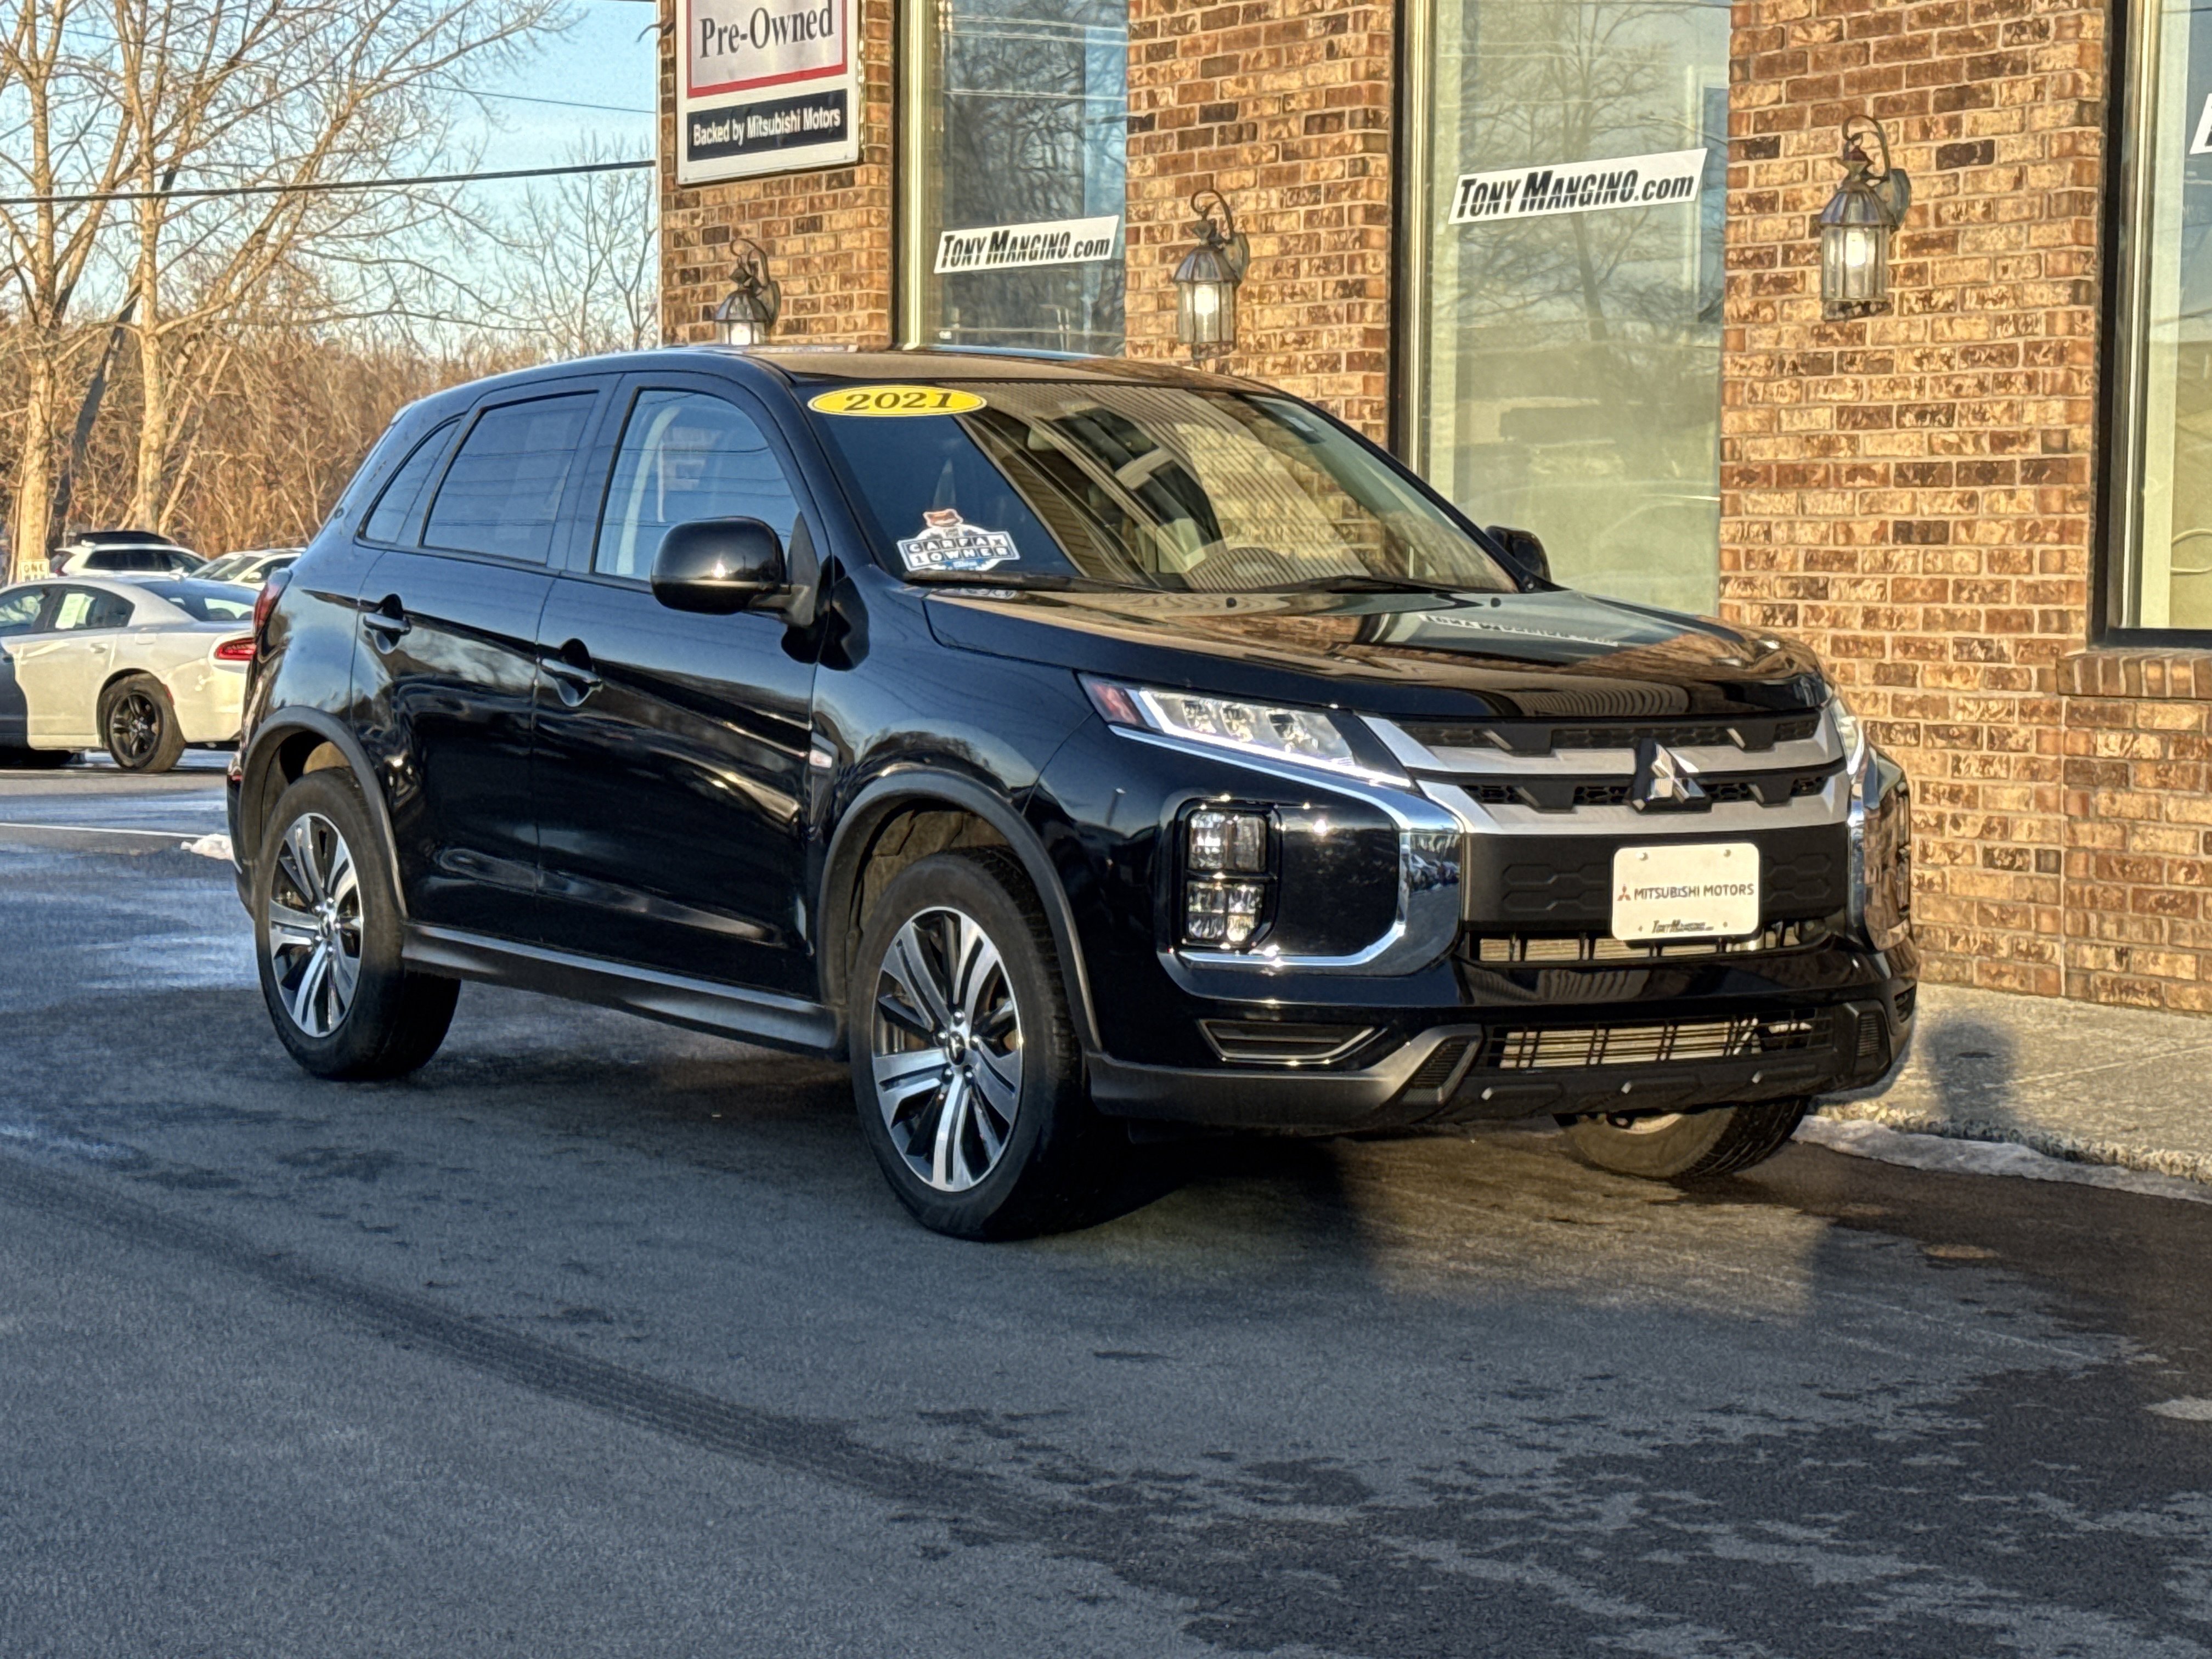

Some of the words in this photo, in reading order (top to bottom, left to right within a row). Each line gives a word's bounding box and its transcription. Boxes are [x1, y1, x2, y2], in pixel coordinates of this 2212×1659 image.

[699, 0, 834, 59] Pre-Owned
[692, 119, 730, 147] Backed
[732, 117, 745, 148] by
[746, 109, 801, 139] Mitsubishi
[803, 106, 841, 132] Motors
[843, 392, 953, 411] 2021
[909, 537, 1003, 553] CARFAX
[1634, 885, 1700, 900] MITSUBISHI
[1703, 883, 1754, 897] MOTORS
